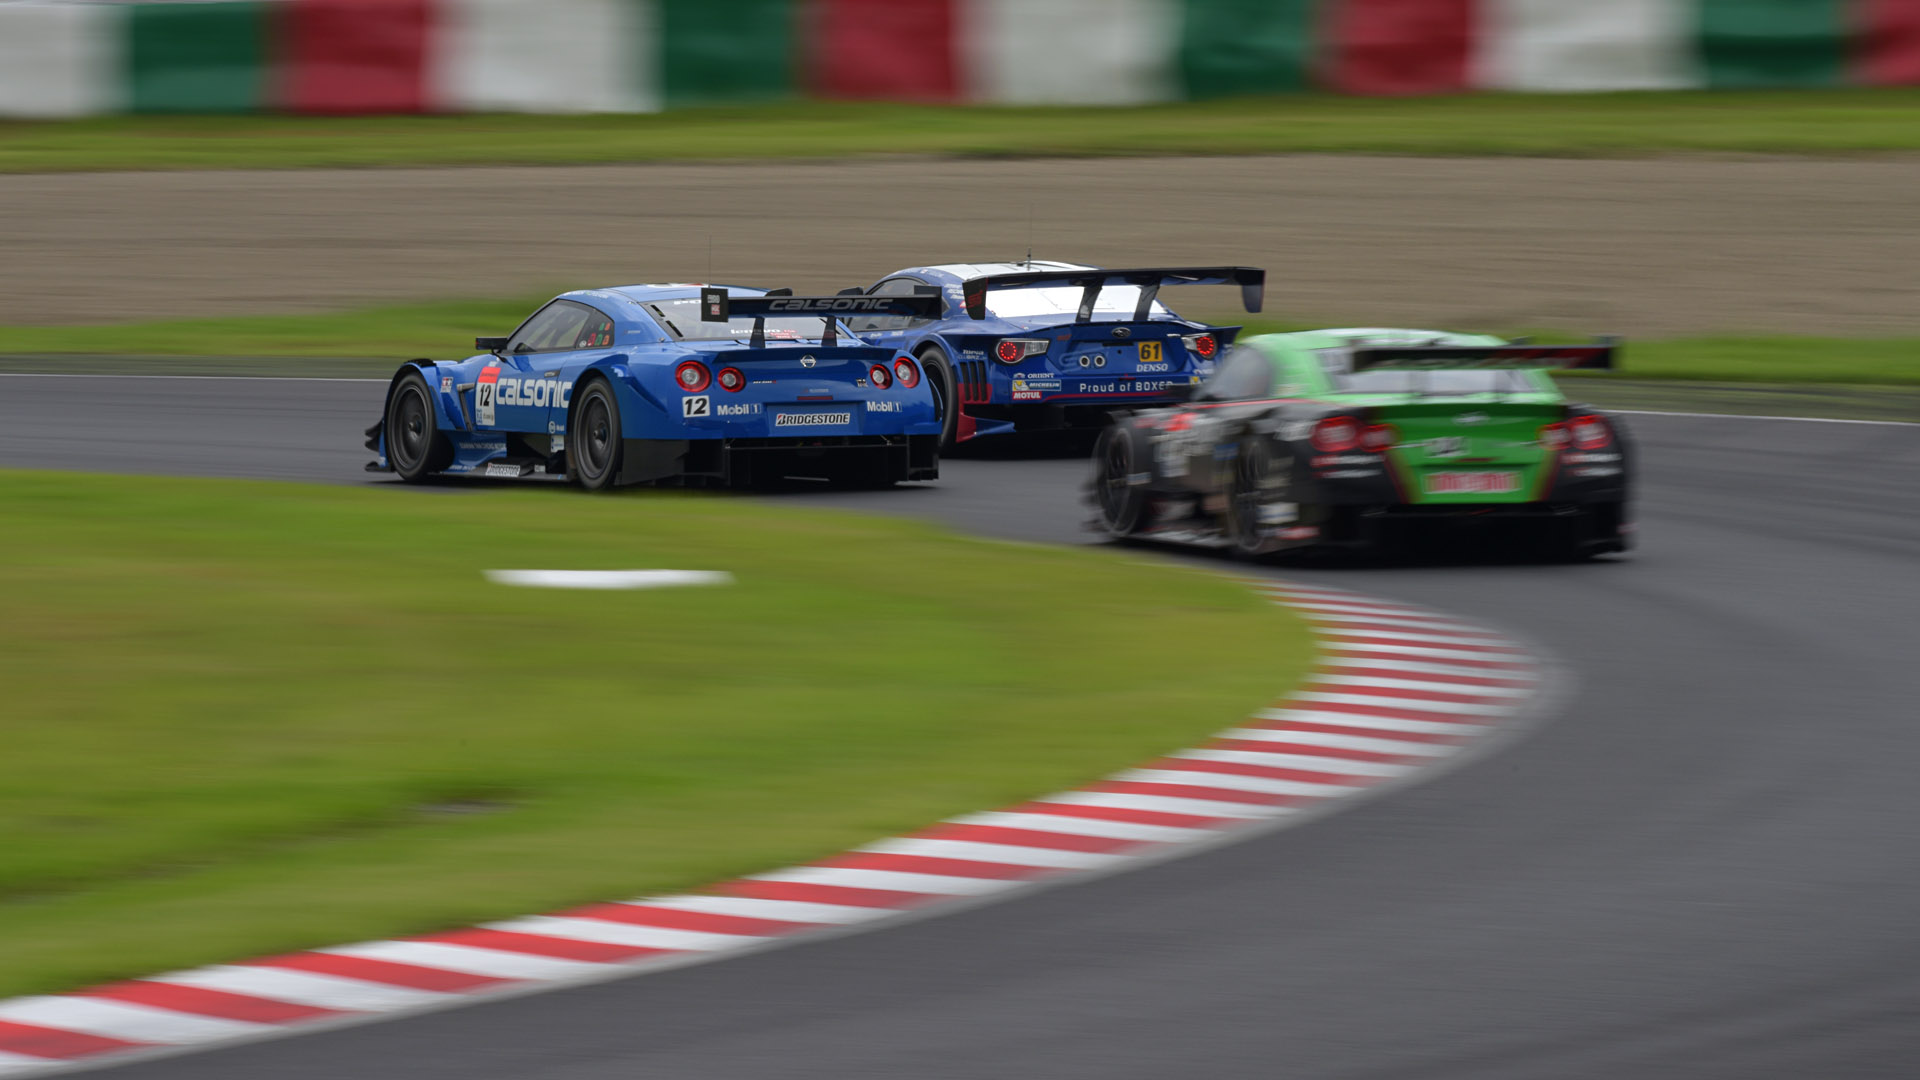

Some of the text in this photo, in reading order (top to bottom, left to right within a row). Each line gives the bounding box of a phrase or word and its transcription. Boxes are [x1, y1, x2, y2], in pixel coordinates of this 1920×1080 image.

[1141, 344, 1161, 360] 61
[1136, 363, 1169, 372] DENSO
[1080, 383, 1115, 393] Proud
[1119, 382, 1131, 392] of
[480, 384, 491, 406] 12
[1013, 391, 1041, 399] MOTUL
[684, 398, 707, 415] 12
[717, 404, 749, 416] Mobil
[867, 401, 893, 412] Mobil
[776, 414, 849, 426] BRIDGESTONE
